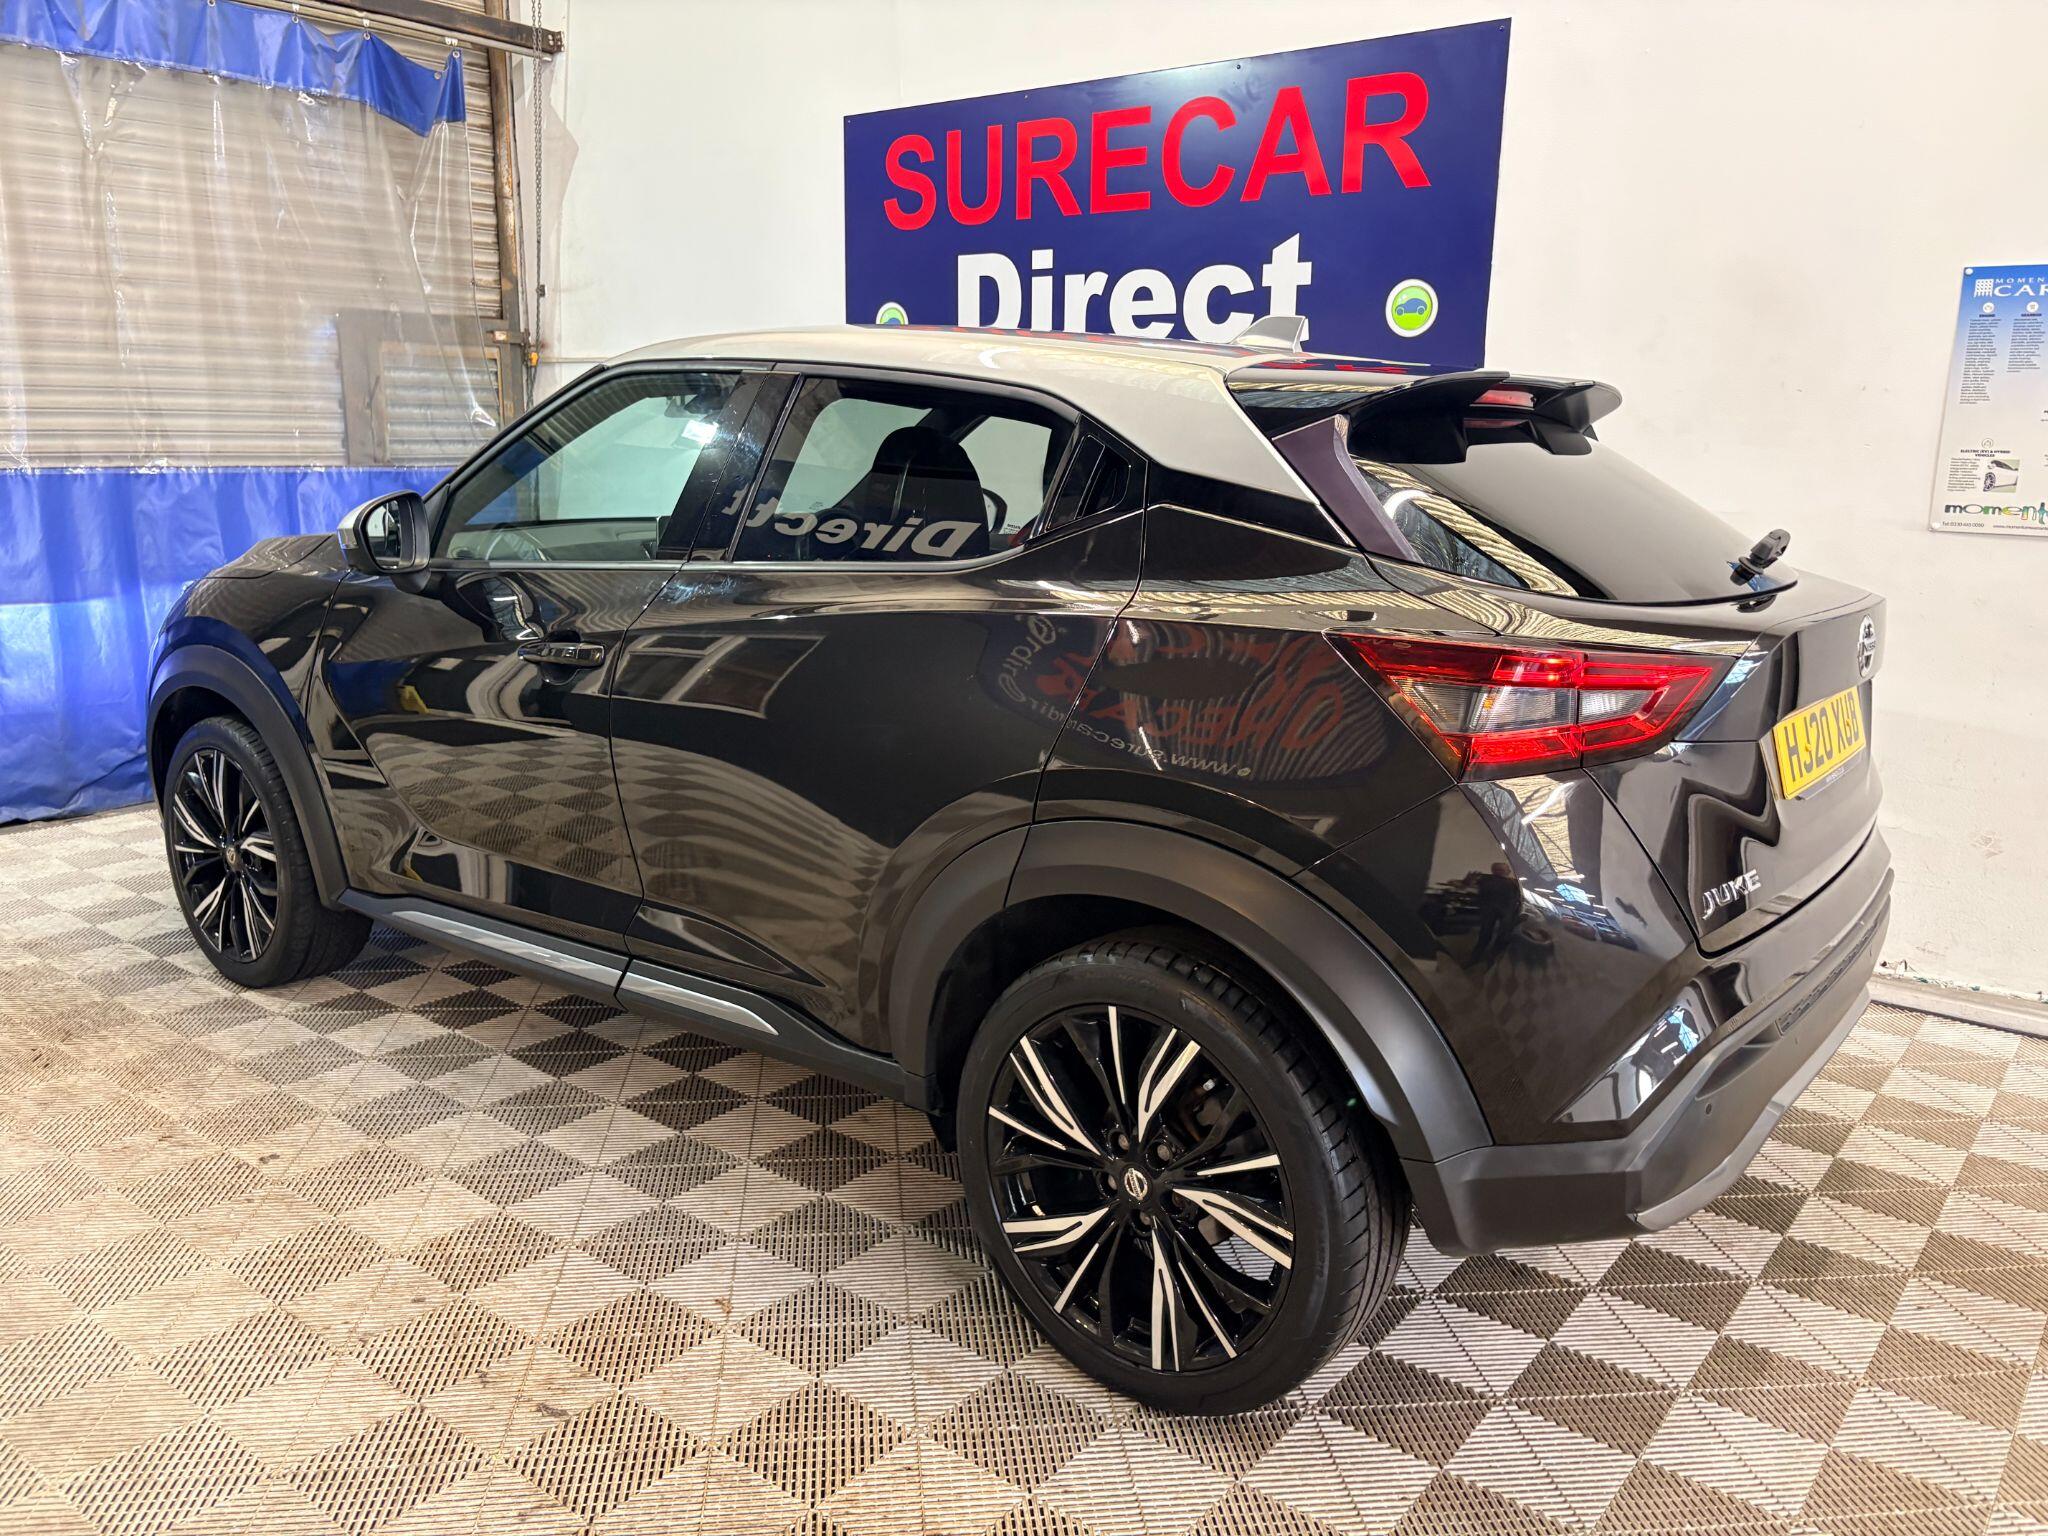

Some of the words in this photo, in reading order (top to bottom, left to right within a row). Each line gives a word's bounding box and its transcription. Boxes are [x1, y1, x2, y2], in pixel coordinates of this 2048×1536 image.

[883, 71, 1432, 231] SURECAR
[957, 232, 1312, 345] Direct
[1784, 706, 1833, 783] HJ20
[1831, 691, 1860, 754] XUB
[1702, 869, 1761, 920] JUKE
